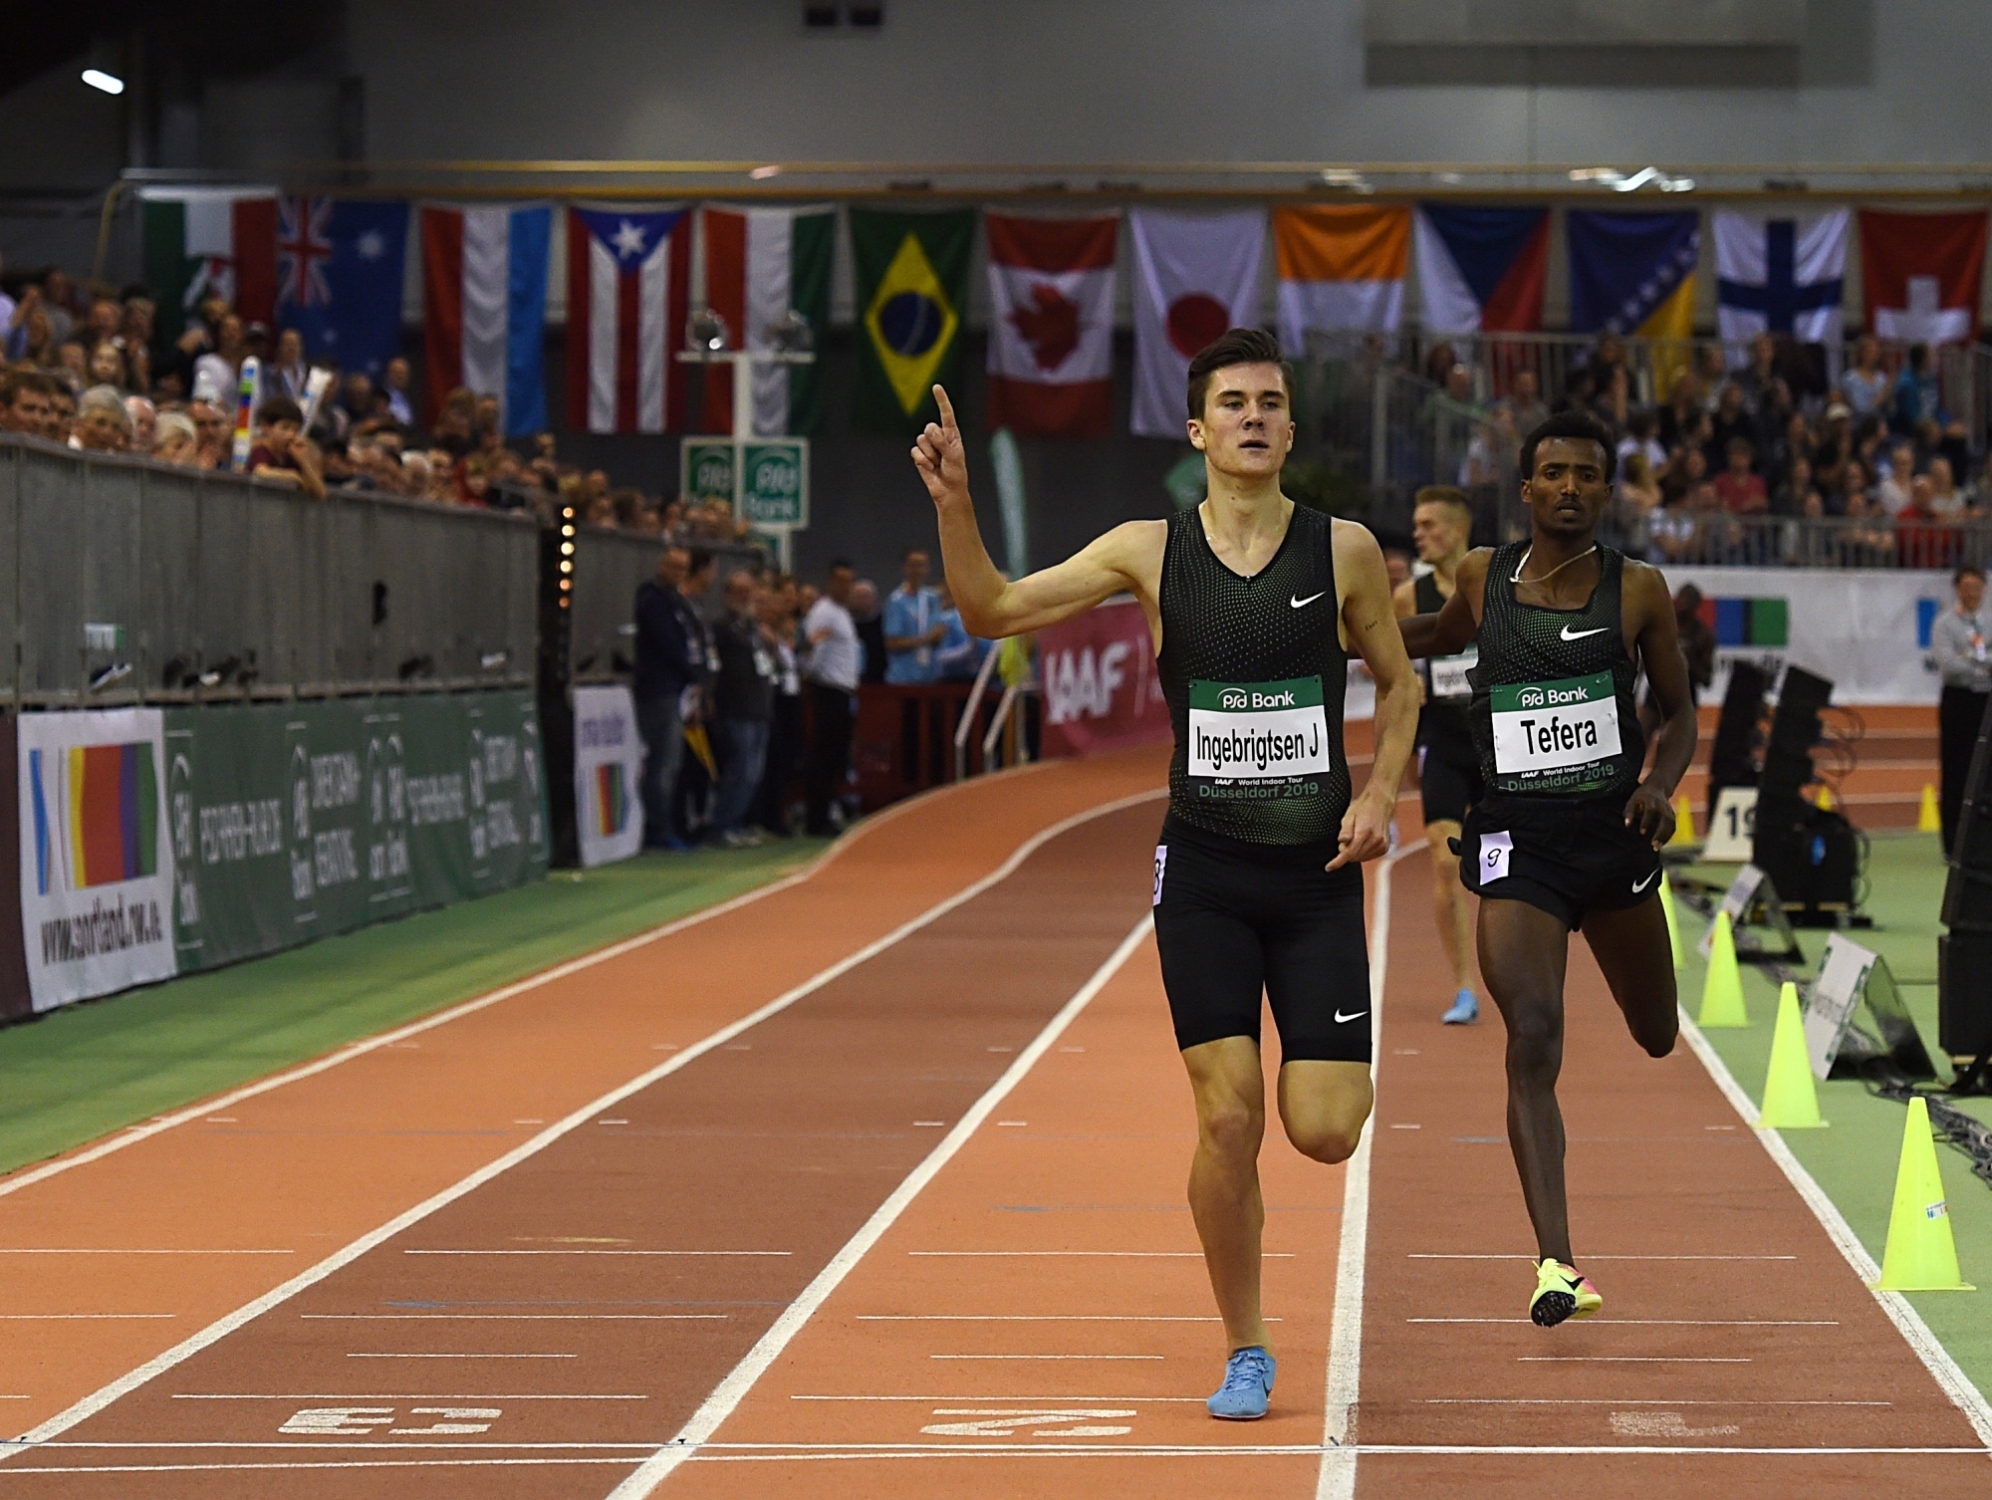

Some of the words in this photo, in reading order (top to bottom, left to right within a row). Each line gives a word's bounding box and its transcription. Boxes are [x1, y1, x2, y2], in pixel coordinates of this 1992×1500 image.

[1045, 641, 1131, 724] IAAF
[1252, 690, 1295, 708] Bank
[1547, 686, 1589, 704] Bank
[1520, 716, 1598, 755] Tefera
[1197, 725, 1304, 771] Ingebrigtsen
[1309, 722, 1319, 758] J
[1508, 773, 1580, 791] Düsseldorf
[1584, 764, 1614, 780] 2019
[1521, 770, 1540, 779] IAAF
[1542, 767, 1563, 777] World
[1564, 765, 1586, 774] Indoor
[1587, 761, 1600, 769] Tour
[1200, 785, 1279, 799] Düsseldorf
[1283, 782, 1319, 797] 2019
[1214, 778, 1234, 786] IAAF
[1238, 778, 1260, 786] World
[1261, 778, 1286, 786] Indoor
[1487, 848, 1502, 868] 9
